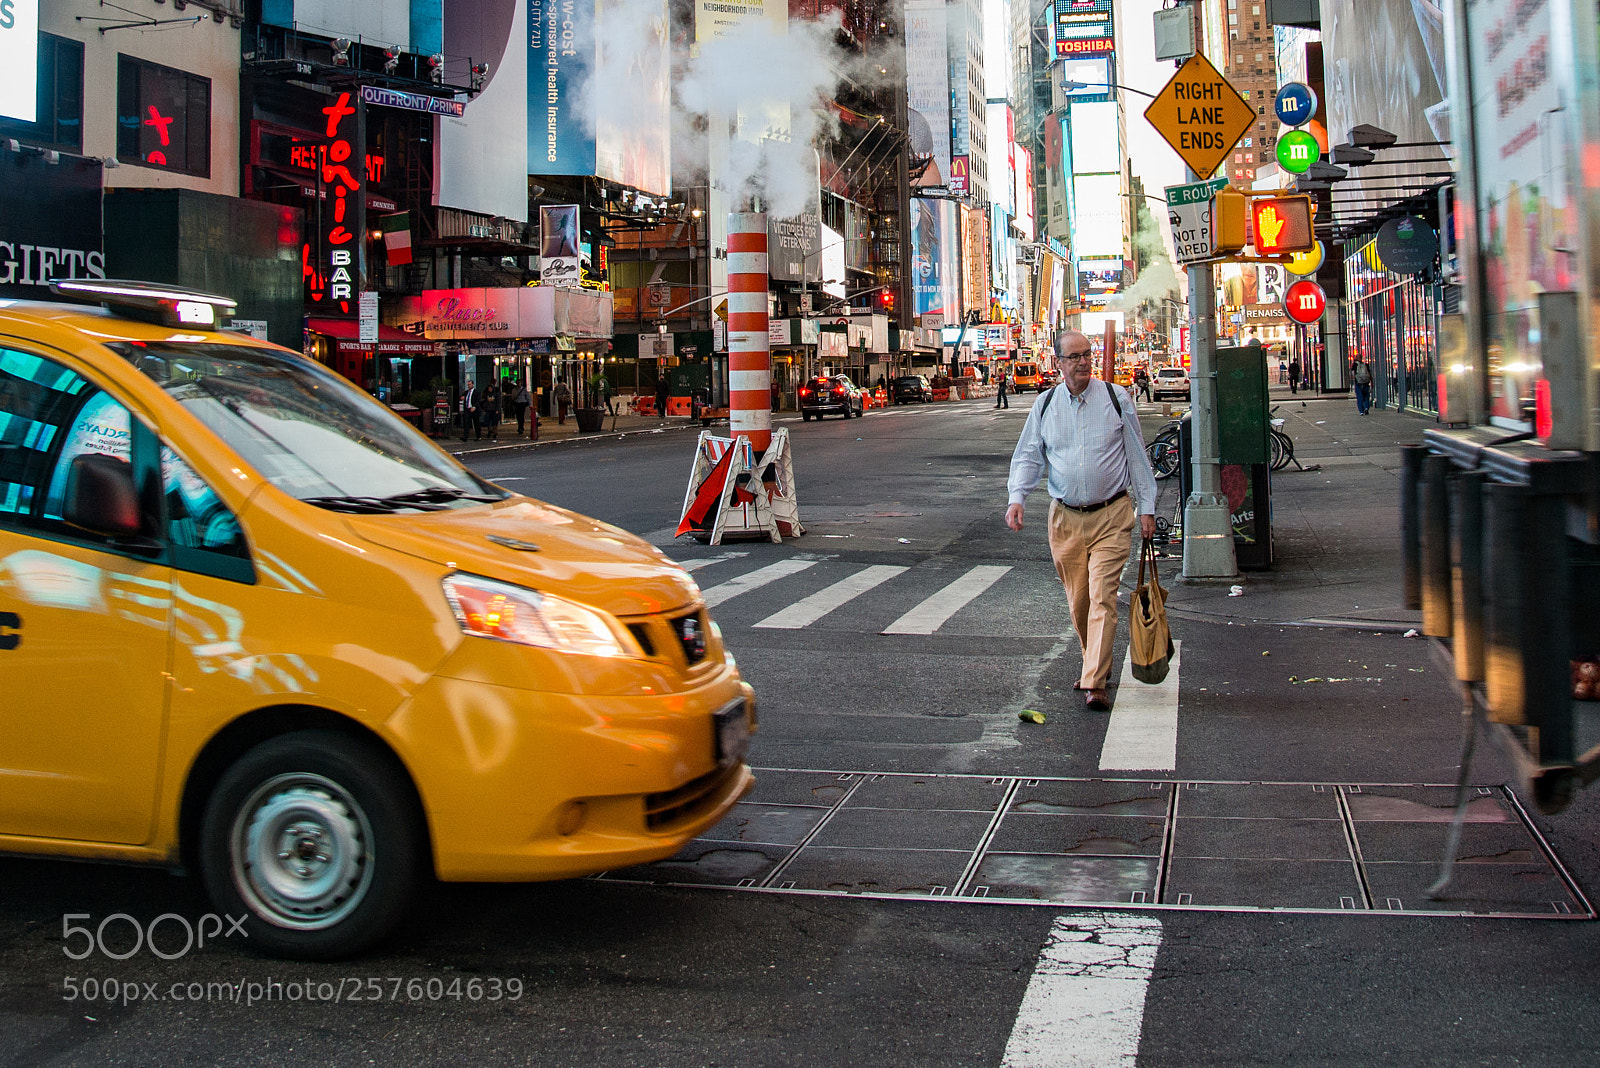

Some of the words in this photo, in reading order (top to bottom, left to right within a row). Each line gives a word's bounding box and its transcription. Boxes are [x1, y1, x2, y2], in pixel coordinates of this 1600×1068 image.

[703, 2, 748, 15] NEIGHBORHOOD
[531, 8, 542, 27] (TTY
[530, 30, 542, 49] 711)
[1056, 39, 1114, 53] TOSHIBA
[547, 68, 559, 104] health
[1174, 82, 1224, 100] RIGHT
[364, 88, 427, 109] OUTFRONT
[433, 100, 463, 116] PRIME
[1281, 96, 1299, 113] m
[1177, 107, 1225, 124] LANE
[547, 106, 559, 162] insurance
[1180, 131, 1225, 149] ENDS
[1289, 144, 1308, 159] m
[1182, 184, 1218, 201] ROUTE
[372, 200, 395, 211] DINNER
[773, 222, 804, 237] VICTORIES
[804, 227, 817, 238] FOR
[1173, 229, 1196, 242] NOT
[0, 240, 106, 287] GIFTS
[970, 216, 982, 299] PALACE
[330, 250, 352, 300] BAR
[1299, 293, 1317, 310] m
[1246, 309, 1286, 318] RENAISS
[488, 322, 509, 331] CLUB
[339, 342, 360, 350] SPORTS
[360, 343, 372, 351] BAR
[1230, 510, 1255, 525] Arts
